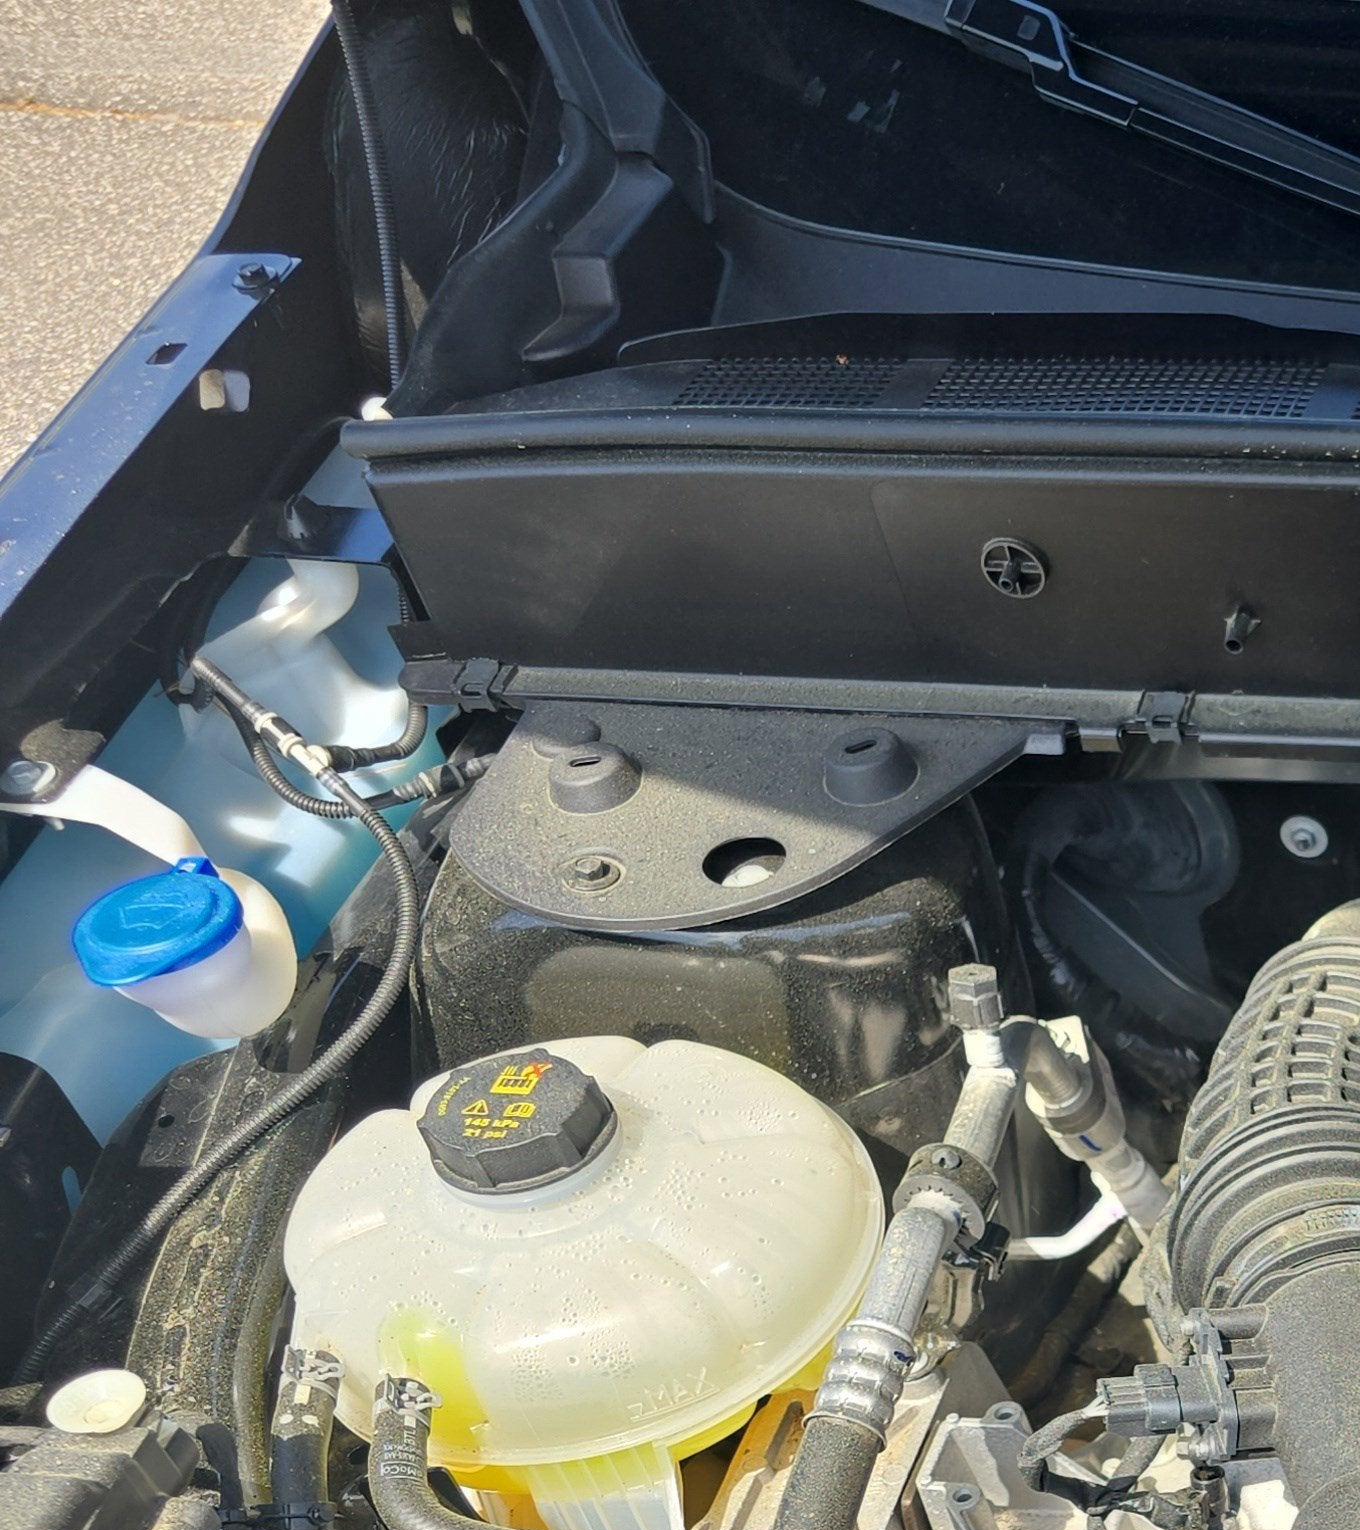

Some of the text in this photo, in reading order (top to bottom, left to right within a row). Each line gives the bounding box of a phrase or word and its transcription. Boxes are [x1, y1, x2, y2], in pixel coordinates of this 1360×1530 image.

[463, 1116, 521, 1129] 145 kPa
[461, 1127, 509, 1140] 21 psi
